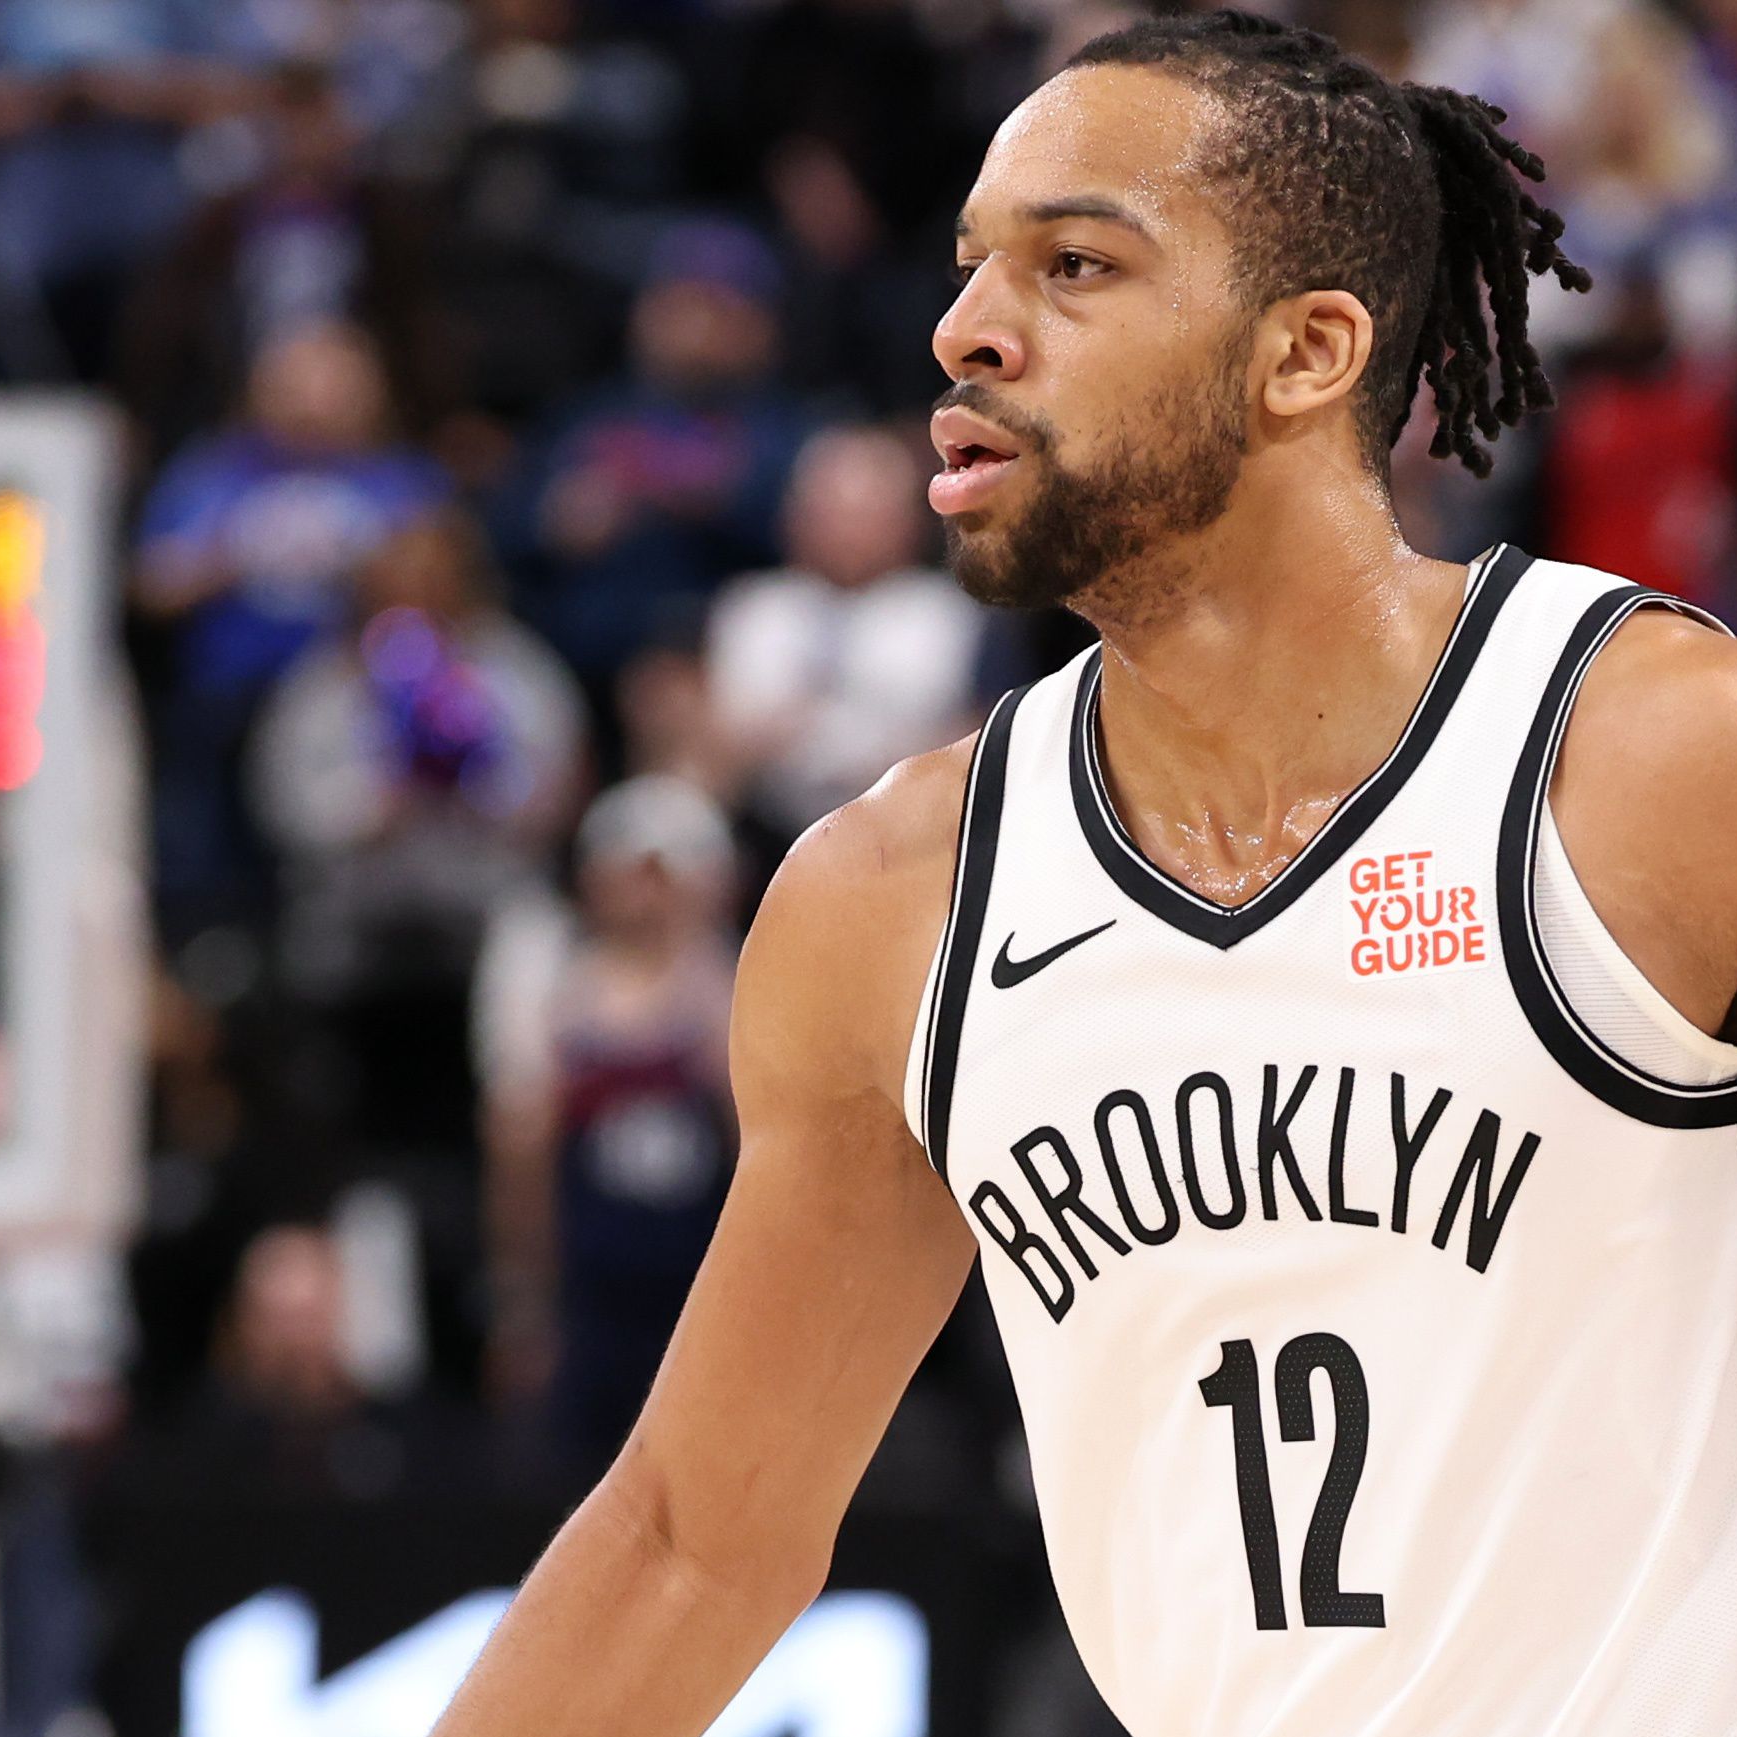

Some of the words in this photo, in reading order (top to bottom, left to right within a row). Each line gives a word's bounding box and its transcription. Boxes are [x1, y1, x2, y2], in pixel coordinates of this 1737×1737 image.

[1349, 850, 1433, 895] GET
[1350, 886, 1477, 935] YOUR
[1351, 925, 1486, 977] GUIDE
[968, 1064, 1542, 1325] BROOKLYN
[1197, 1332, 1387, 1631] 12
